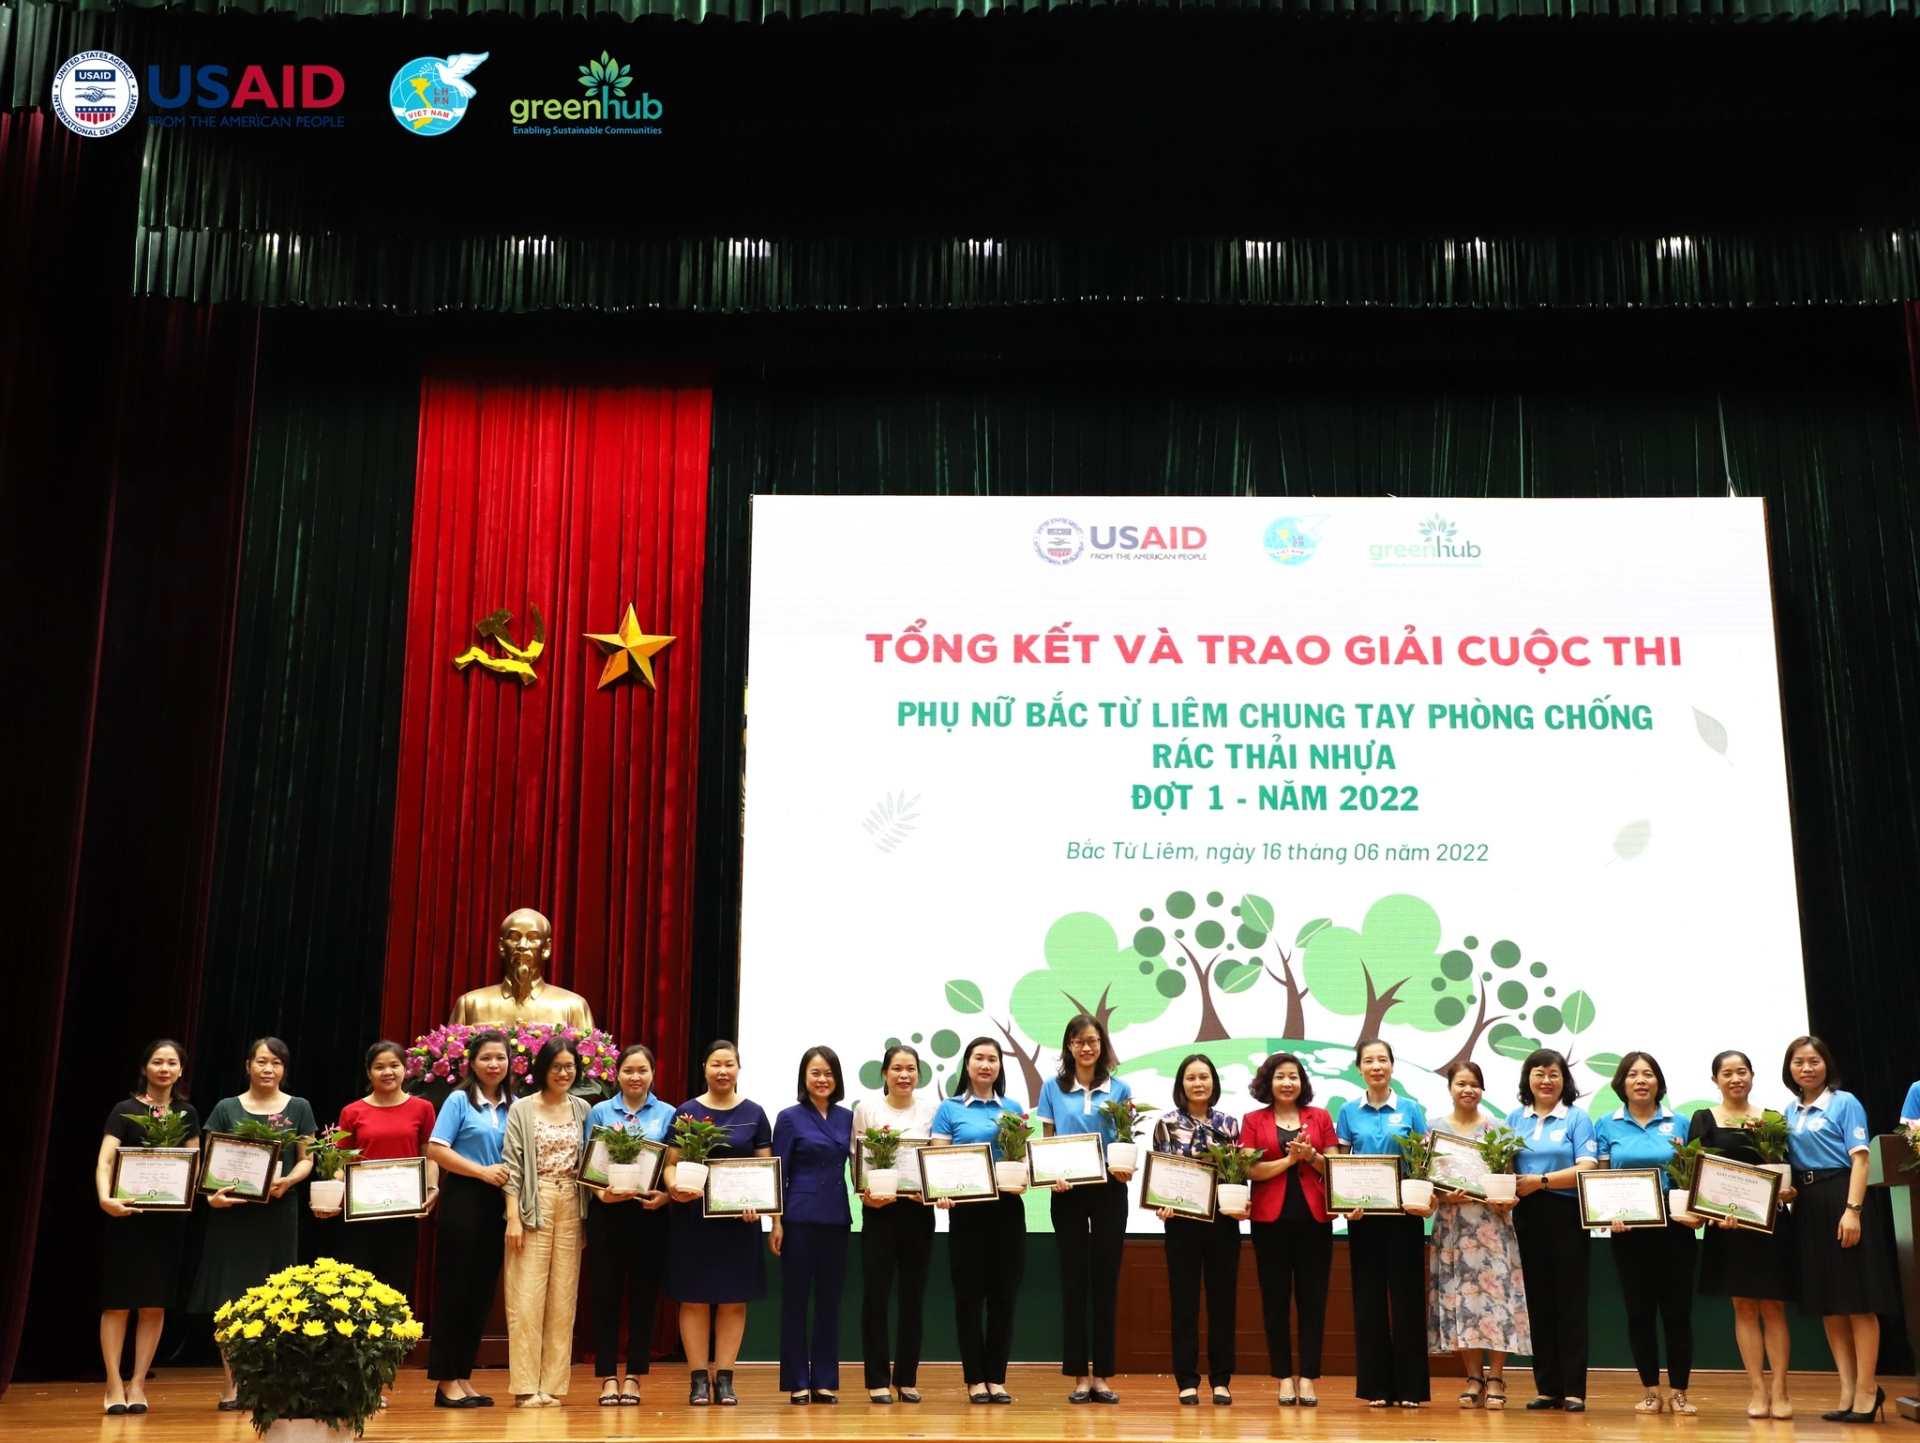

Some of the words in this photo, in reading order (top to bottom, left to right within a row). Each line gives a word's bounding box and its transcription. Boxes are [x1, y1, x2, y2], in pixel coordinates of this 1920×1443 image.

[1091, 526, 1207, 549] USAID
[1369, 535, 1481, 560] greenhub
[866, 618, 997, 664] TỔNG
[1014, 622, 1099, 663] KẾT
[1114, 627, 1183, 664] VÀ
[1197, 635, 1330, 665] TRAO
[1345, 624, 1442, 665] GIẢI
[1458, 628, 1591, 674] CUỘC
[1603, 637, 1681, 666] THI
[898, 701, 959, 733] PHỤ
[972, 696, 1016, 727] NỮ
[1026, 691, 1088, 728] BẮC
[1098, 696, 1142, 728] TỪ
[1152, 696, 1227, 728] LIÊM
[1239, 703, 1345, 729] CHUNG
[1355, 703, 1415, 729] TAY
[1428, 698, 1534, 730] PHÒNG
[1544, 695, 1653, 730] CHỐNG
[1153, 737, 1214, 769] RÁC
[1224, 734, 1297, 769] THẢI
[1310, 739, 1396, 776] NHỰA
[1131, 781, 1193, 816] ĐỢT
[1209, 785, 1224, 810] 1
[1259, 780, 1327, 811] NĂM
[1340, 785, 1419, 811] 2022
[1067, 839, 1105, 859] Bắc
[1112, 842, 1138, 859] Từ
[1142, 842, 1198, 861] Liêm,
[1206, 843, 1255, 864] ngày
[1263, 842, 1281, 860] 16
[1288, 843, 1347, 865] tháng
[1354, 843, 1379, 860] 06
[1386, 844, 1429, 861] năm
[1436, 843, 1488, 861] 2022
